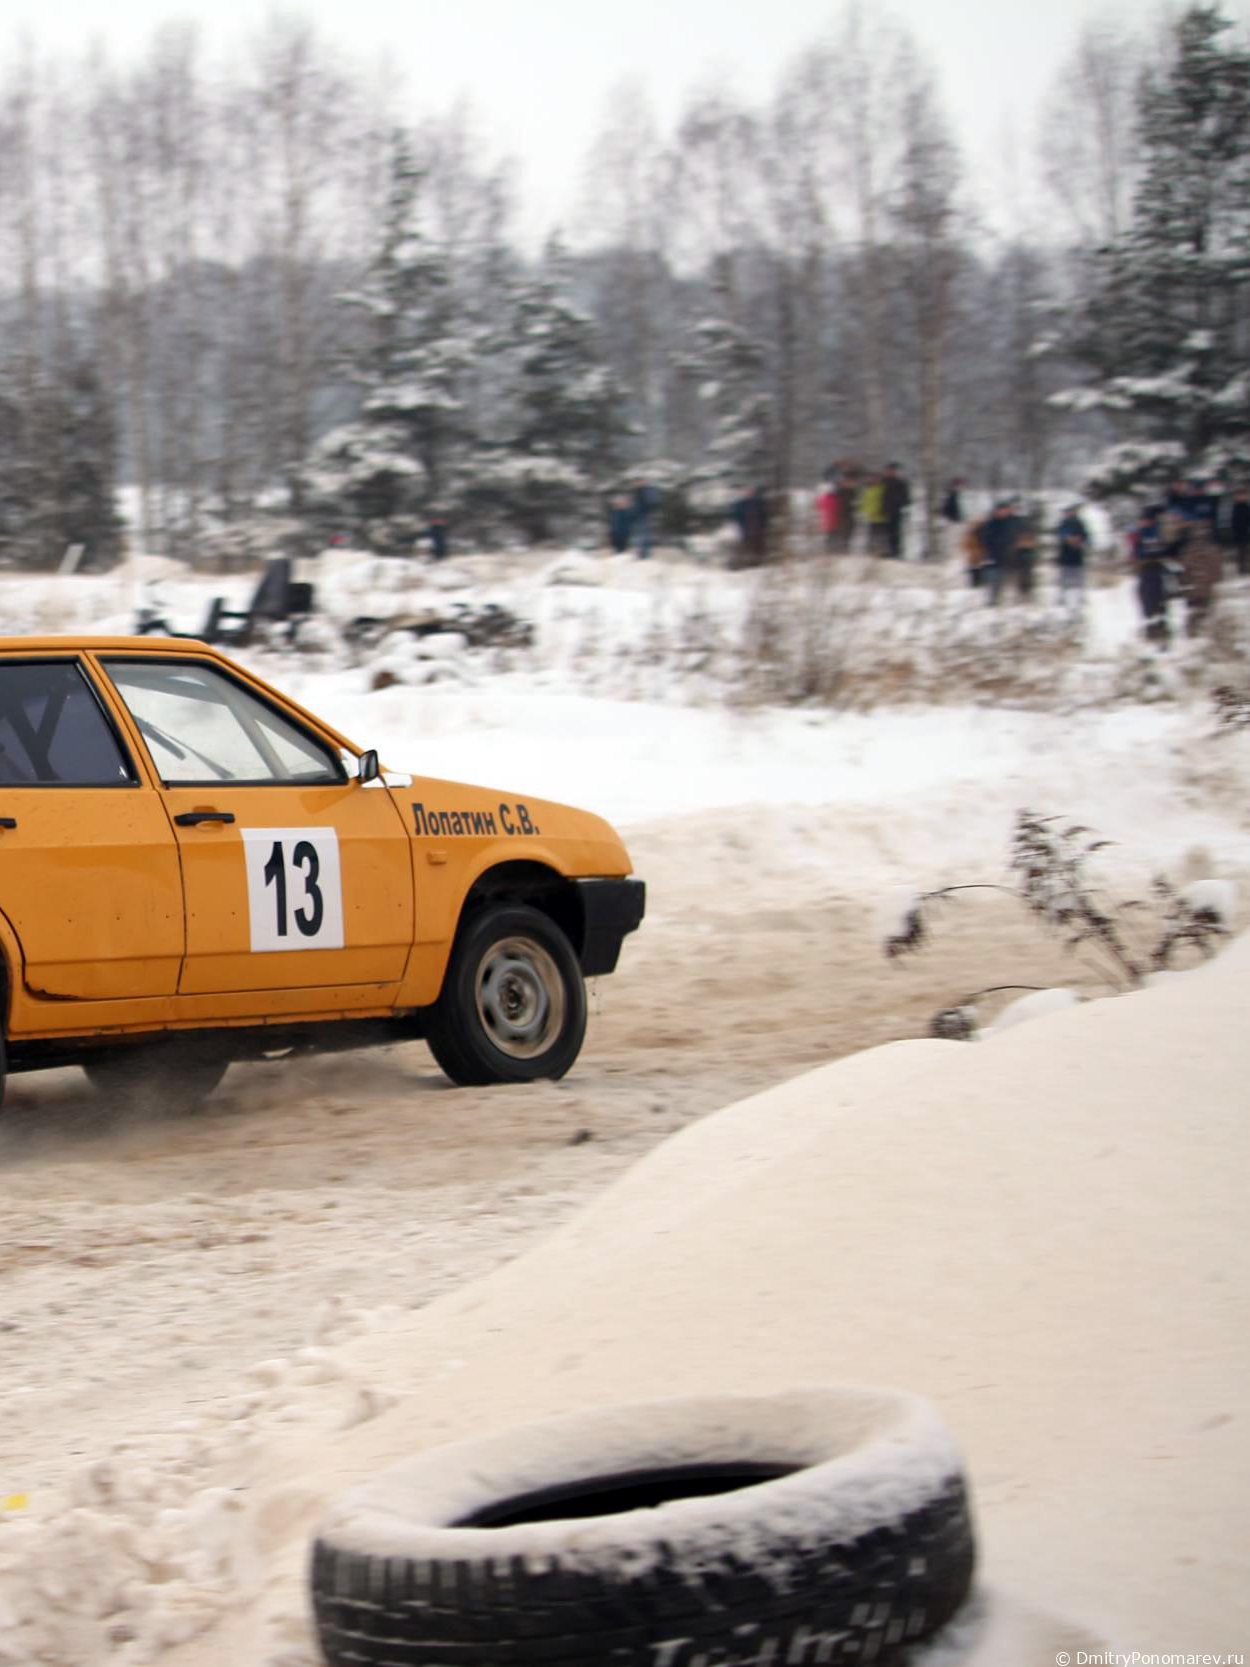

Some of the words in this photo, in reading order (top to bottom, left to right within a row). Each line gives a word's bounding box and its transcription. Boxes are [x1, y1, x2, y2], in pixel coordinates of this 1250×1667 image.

[411, 803, 498, 836] Лопатин
[499, 803, 540, 836] С.В.
[264, 840, 323, 937] 13
